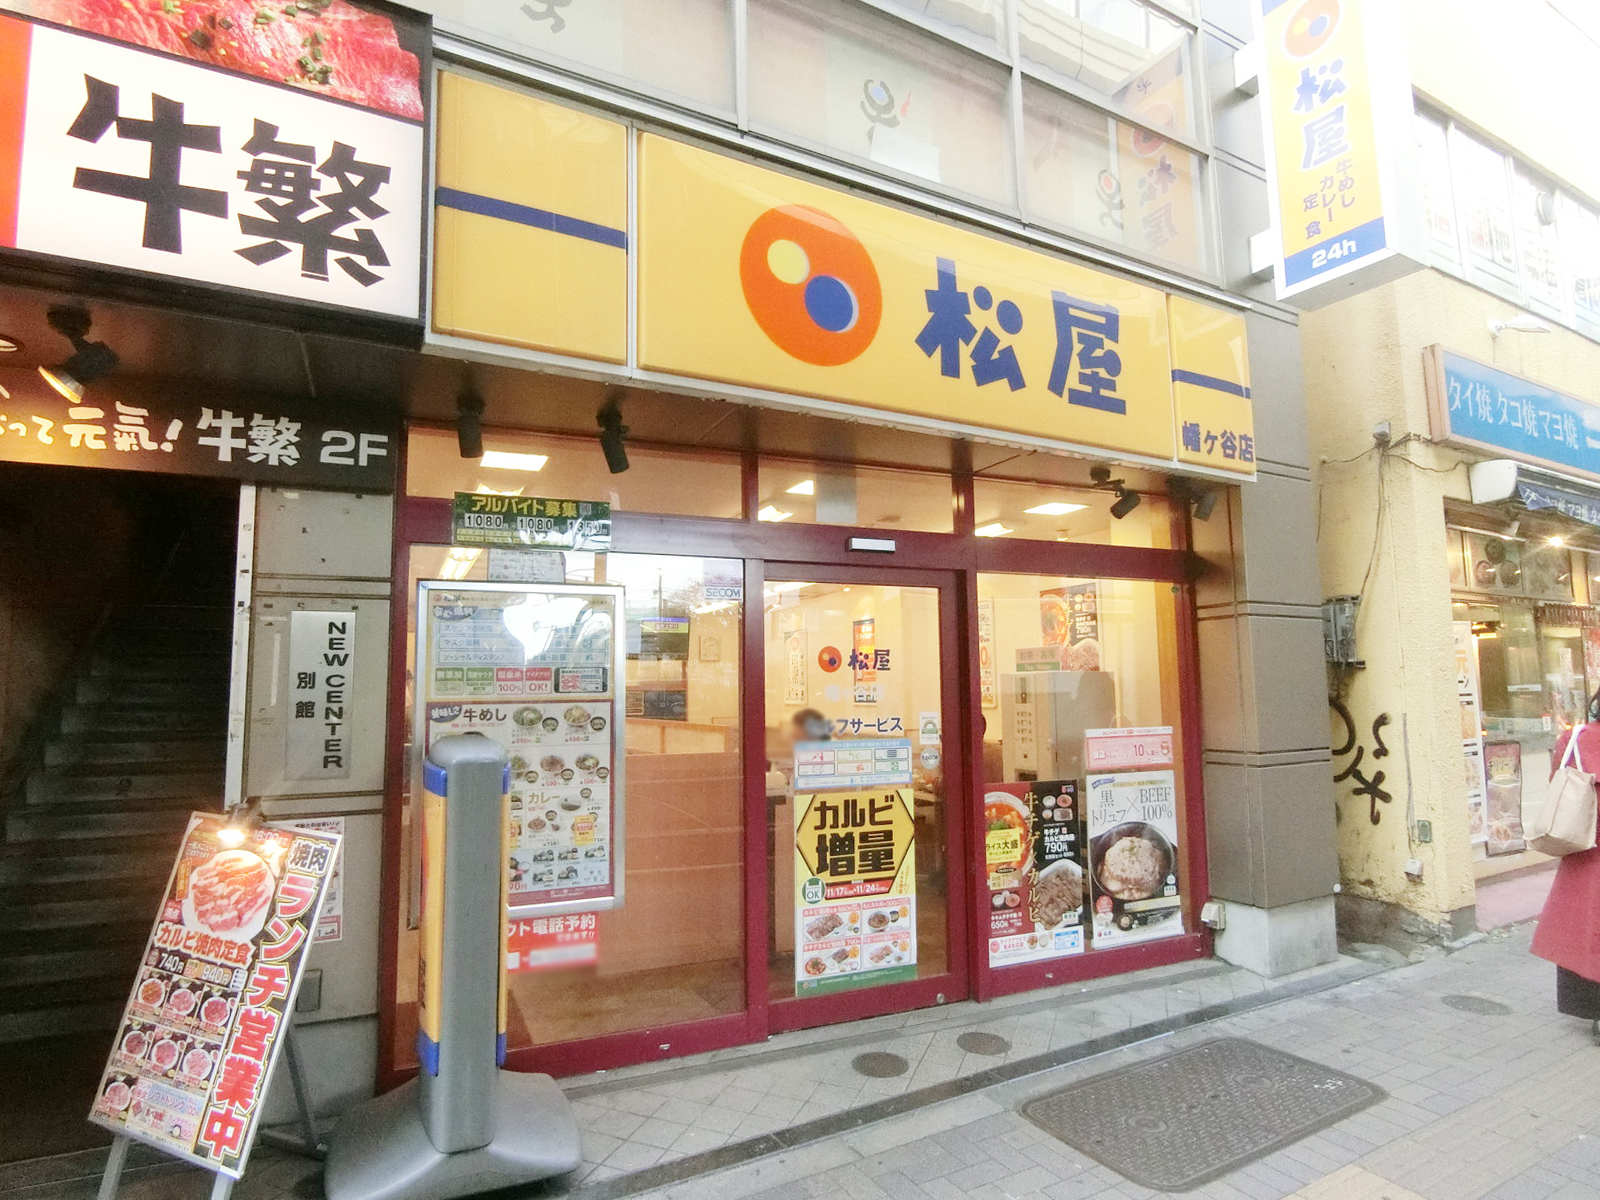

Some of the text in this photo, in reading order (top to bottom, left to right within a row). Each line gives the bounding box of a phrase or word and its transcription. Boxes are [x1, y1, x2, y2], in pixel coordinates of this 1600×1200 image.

[1293, 58, 1349, 170] 松屋
[66, 73, 391, 287] 牛繁
[1336, 158, 1355, 209] 牛めし
[1319, 175, 1336, 222] カレー
[1303, 192, 1321, 240] 定食
[1311, 239, 1356, 269] 24h
[915, 256, 1126, 415] 松屋
[198, 407, 301, 467] 牛繁
[319, 430, 389, 467] 2F
[471, 496, 577, 518] アルバイト募集
[706, 588, 741, 598] SECOM
[848, 648, 891, 671] 松屋
[295, 671, 316, 719] 別館
[323, 621, 350, 769] NEW CENTER
[529, 682, 548, 692] OK!
[463, 707, 507, 722] 牛めし
[528, 792, 560, 805] カレー
[1100, 789, 1114, 806] 黒
[1139, 787, 1171, 804] BEEF
[813, 795, 895, 830] カルビ
[1091, 809, 1127, 827] トリュフ
[1141, 804, 1173, 822] 100%
[289, 843, 329, 873] 焼肉
[816, 830, 896, 877] 増量
[986, 839, 1019, 851] ライス大盛
[806, 890, 820, 899] OK
[157, 924, 252, 966] カルビ焼肉定食
[158, 953, 185, 974] 740円
